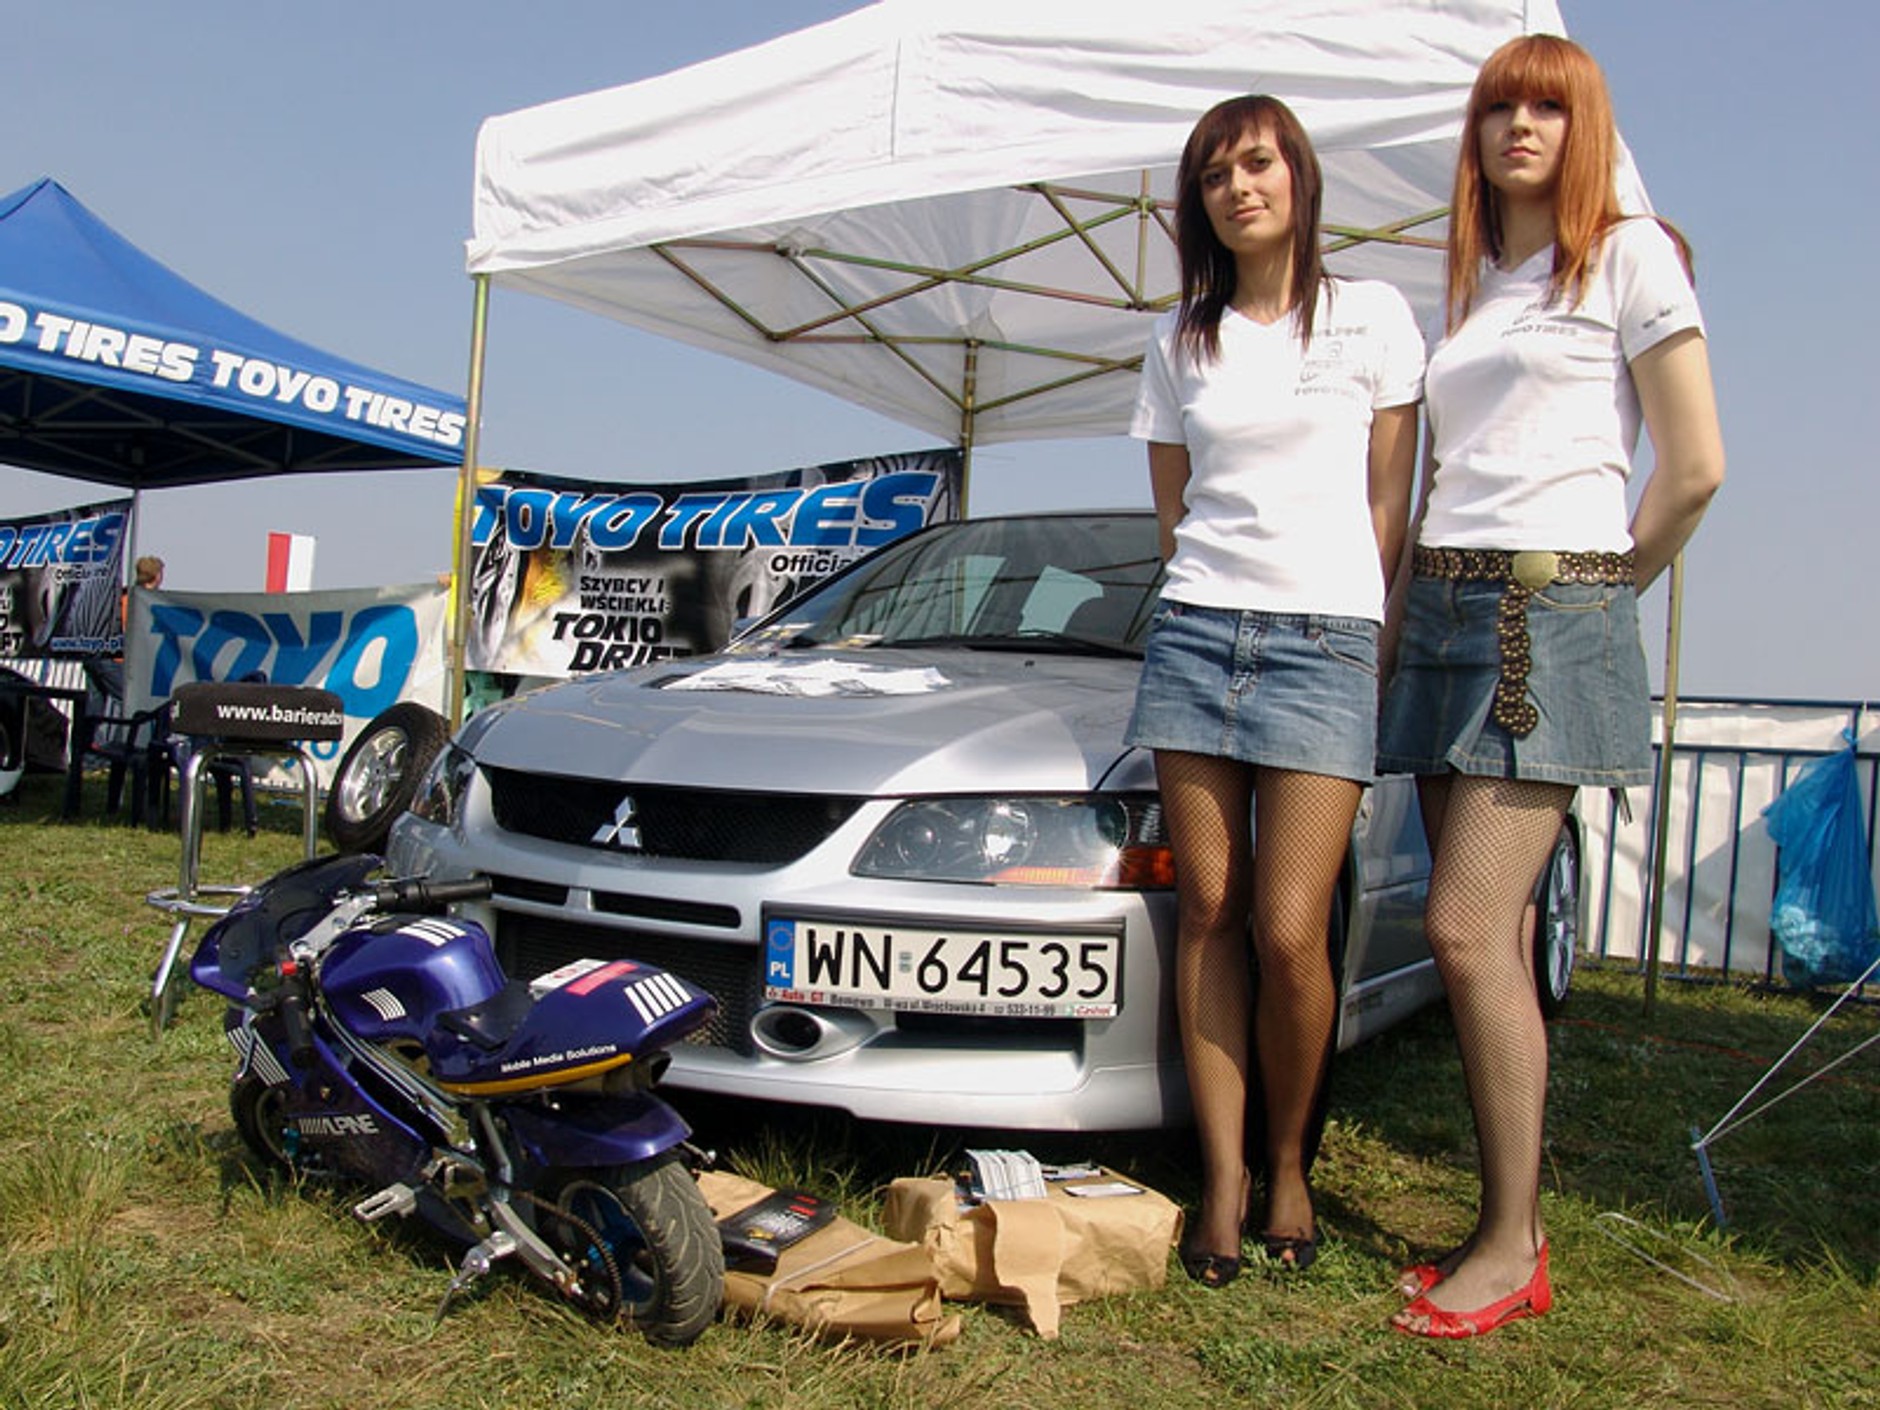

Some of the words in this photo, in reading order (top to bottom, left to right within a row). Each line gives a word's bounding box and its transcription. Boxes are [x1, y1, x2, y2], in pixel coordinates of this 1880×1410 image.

[35, 311, 198, 383] TIRES
[211, 350, 339, 413] TOYO
[344, 385, 467, 446] TIRES
[470, 484, 664, 550] TOYO
[659, 470, 942, 550] TIRES
[7, 512, 126, 570] TIRES
[580, 576, 651, 594] SZYBCY
[657, 579, 665, 594] I
[552, 612, 662, 644] TOKIO
[150, 604, 418, 718] TOYO
[769, 961, 791, 979] PL
[807, 929, 892, 990] WN
[917, 937, 1109, 998] 64535
[533, 1053, 564, 1067] Media
[565, 1044, 618, 1061] Solutions
